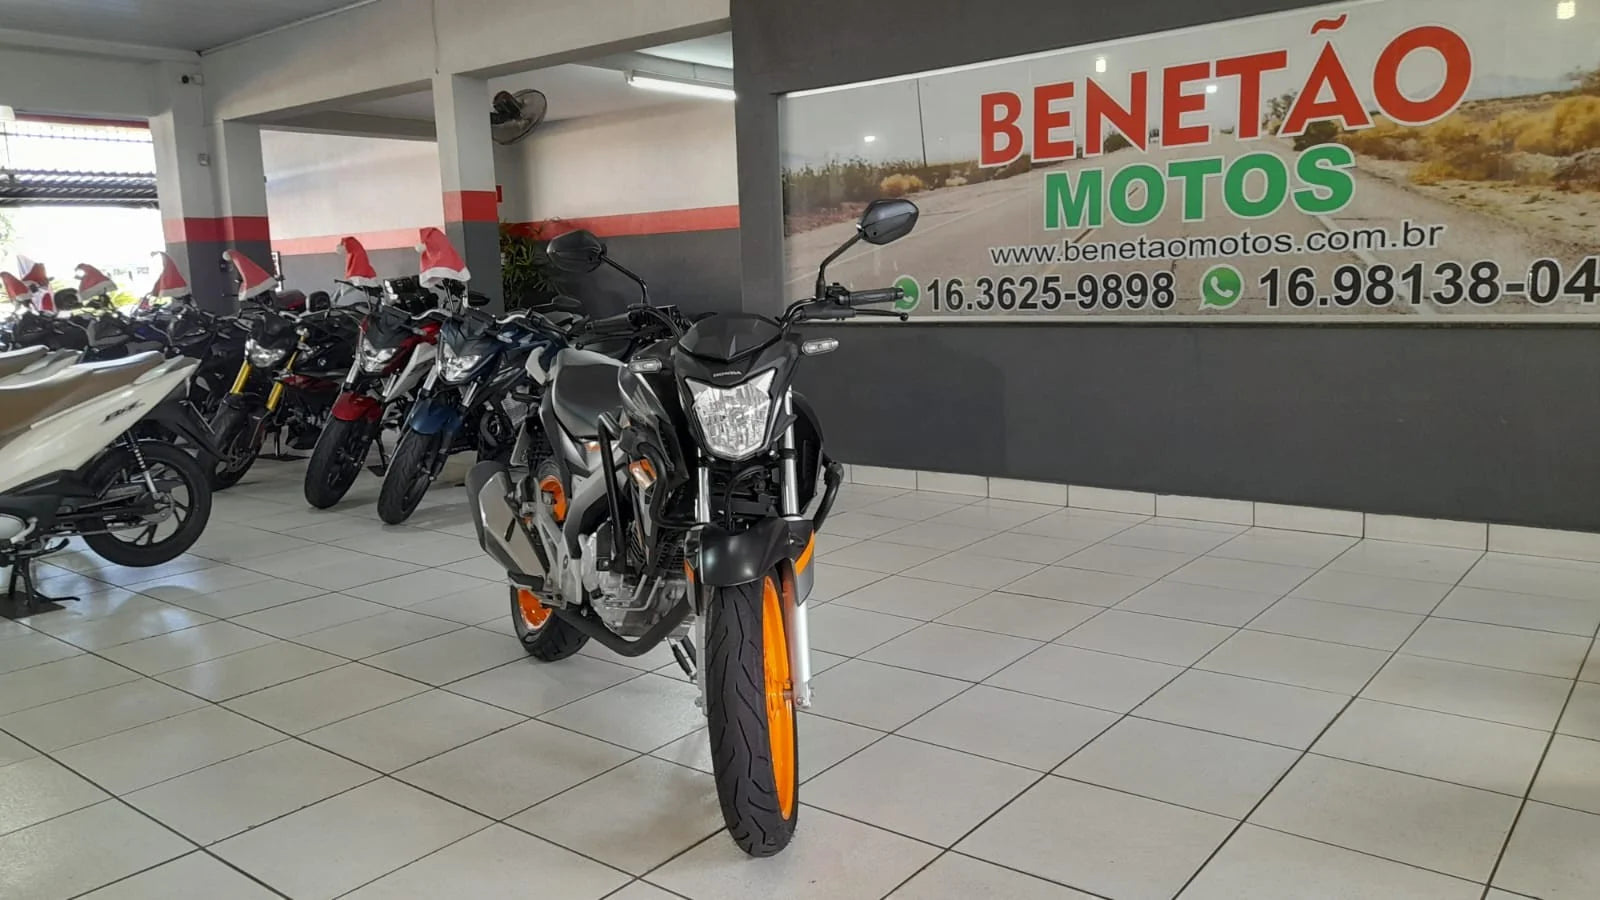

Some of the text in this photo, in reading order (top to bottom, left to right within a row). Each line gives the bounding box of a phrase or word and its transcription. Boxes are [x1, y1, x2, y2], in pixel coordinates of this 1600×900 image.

[979, 14, 1472, 167] BENETÃO
[1044, 144, 1356, 230] MOTOS
[991, 221, 1444, 264] www.benetaomotos.com.br
[927, 272, 1176, 311] 16.3625-9898
